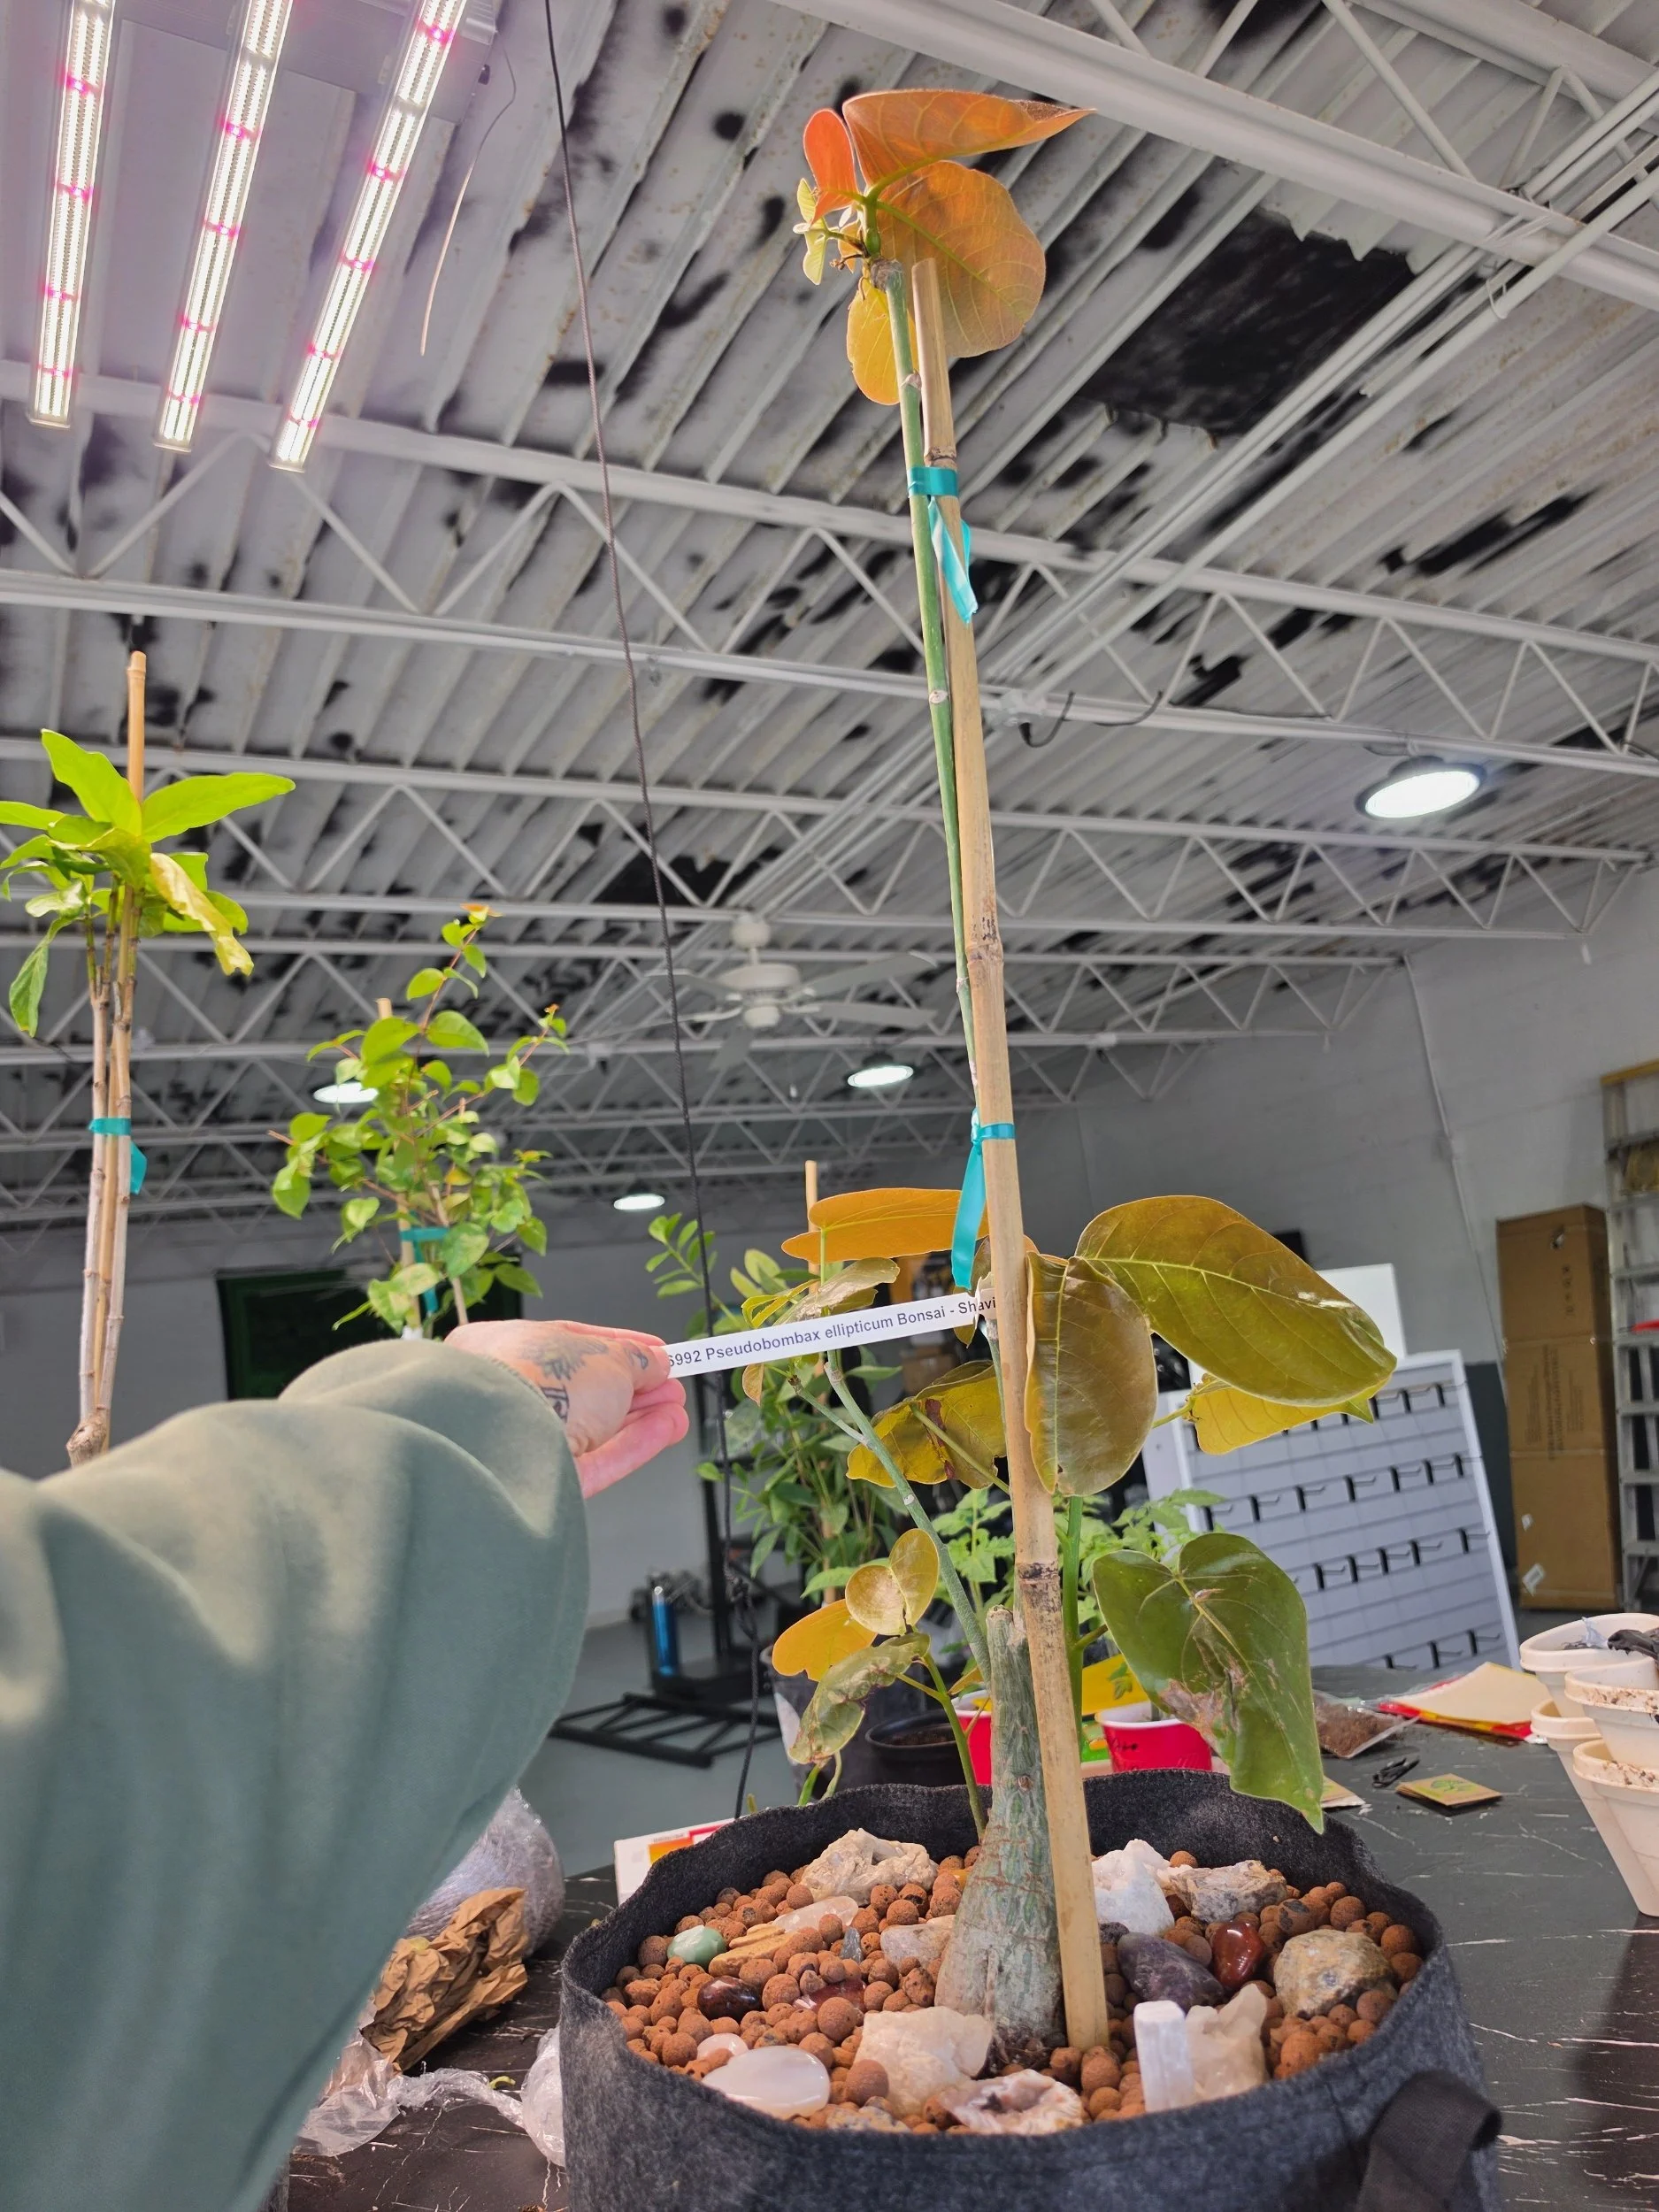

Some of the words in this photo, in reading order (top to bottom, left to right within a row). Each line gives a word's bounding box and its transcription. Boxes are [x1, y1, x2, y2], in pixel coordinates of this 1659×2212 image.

[705, 1330, 821, 1360] Pseudobombax
[826, 1317, 894, 1338] ellipticum
[897, 1306, 946, 1325] Bonsai
